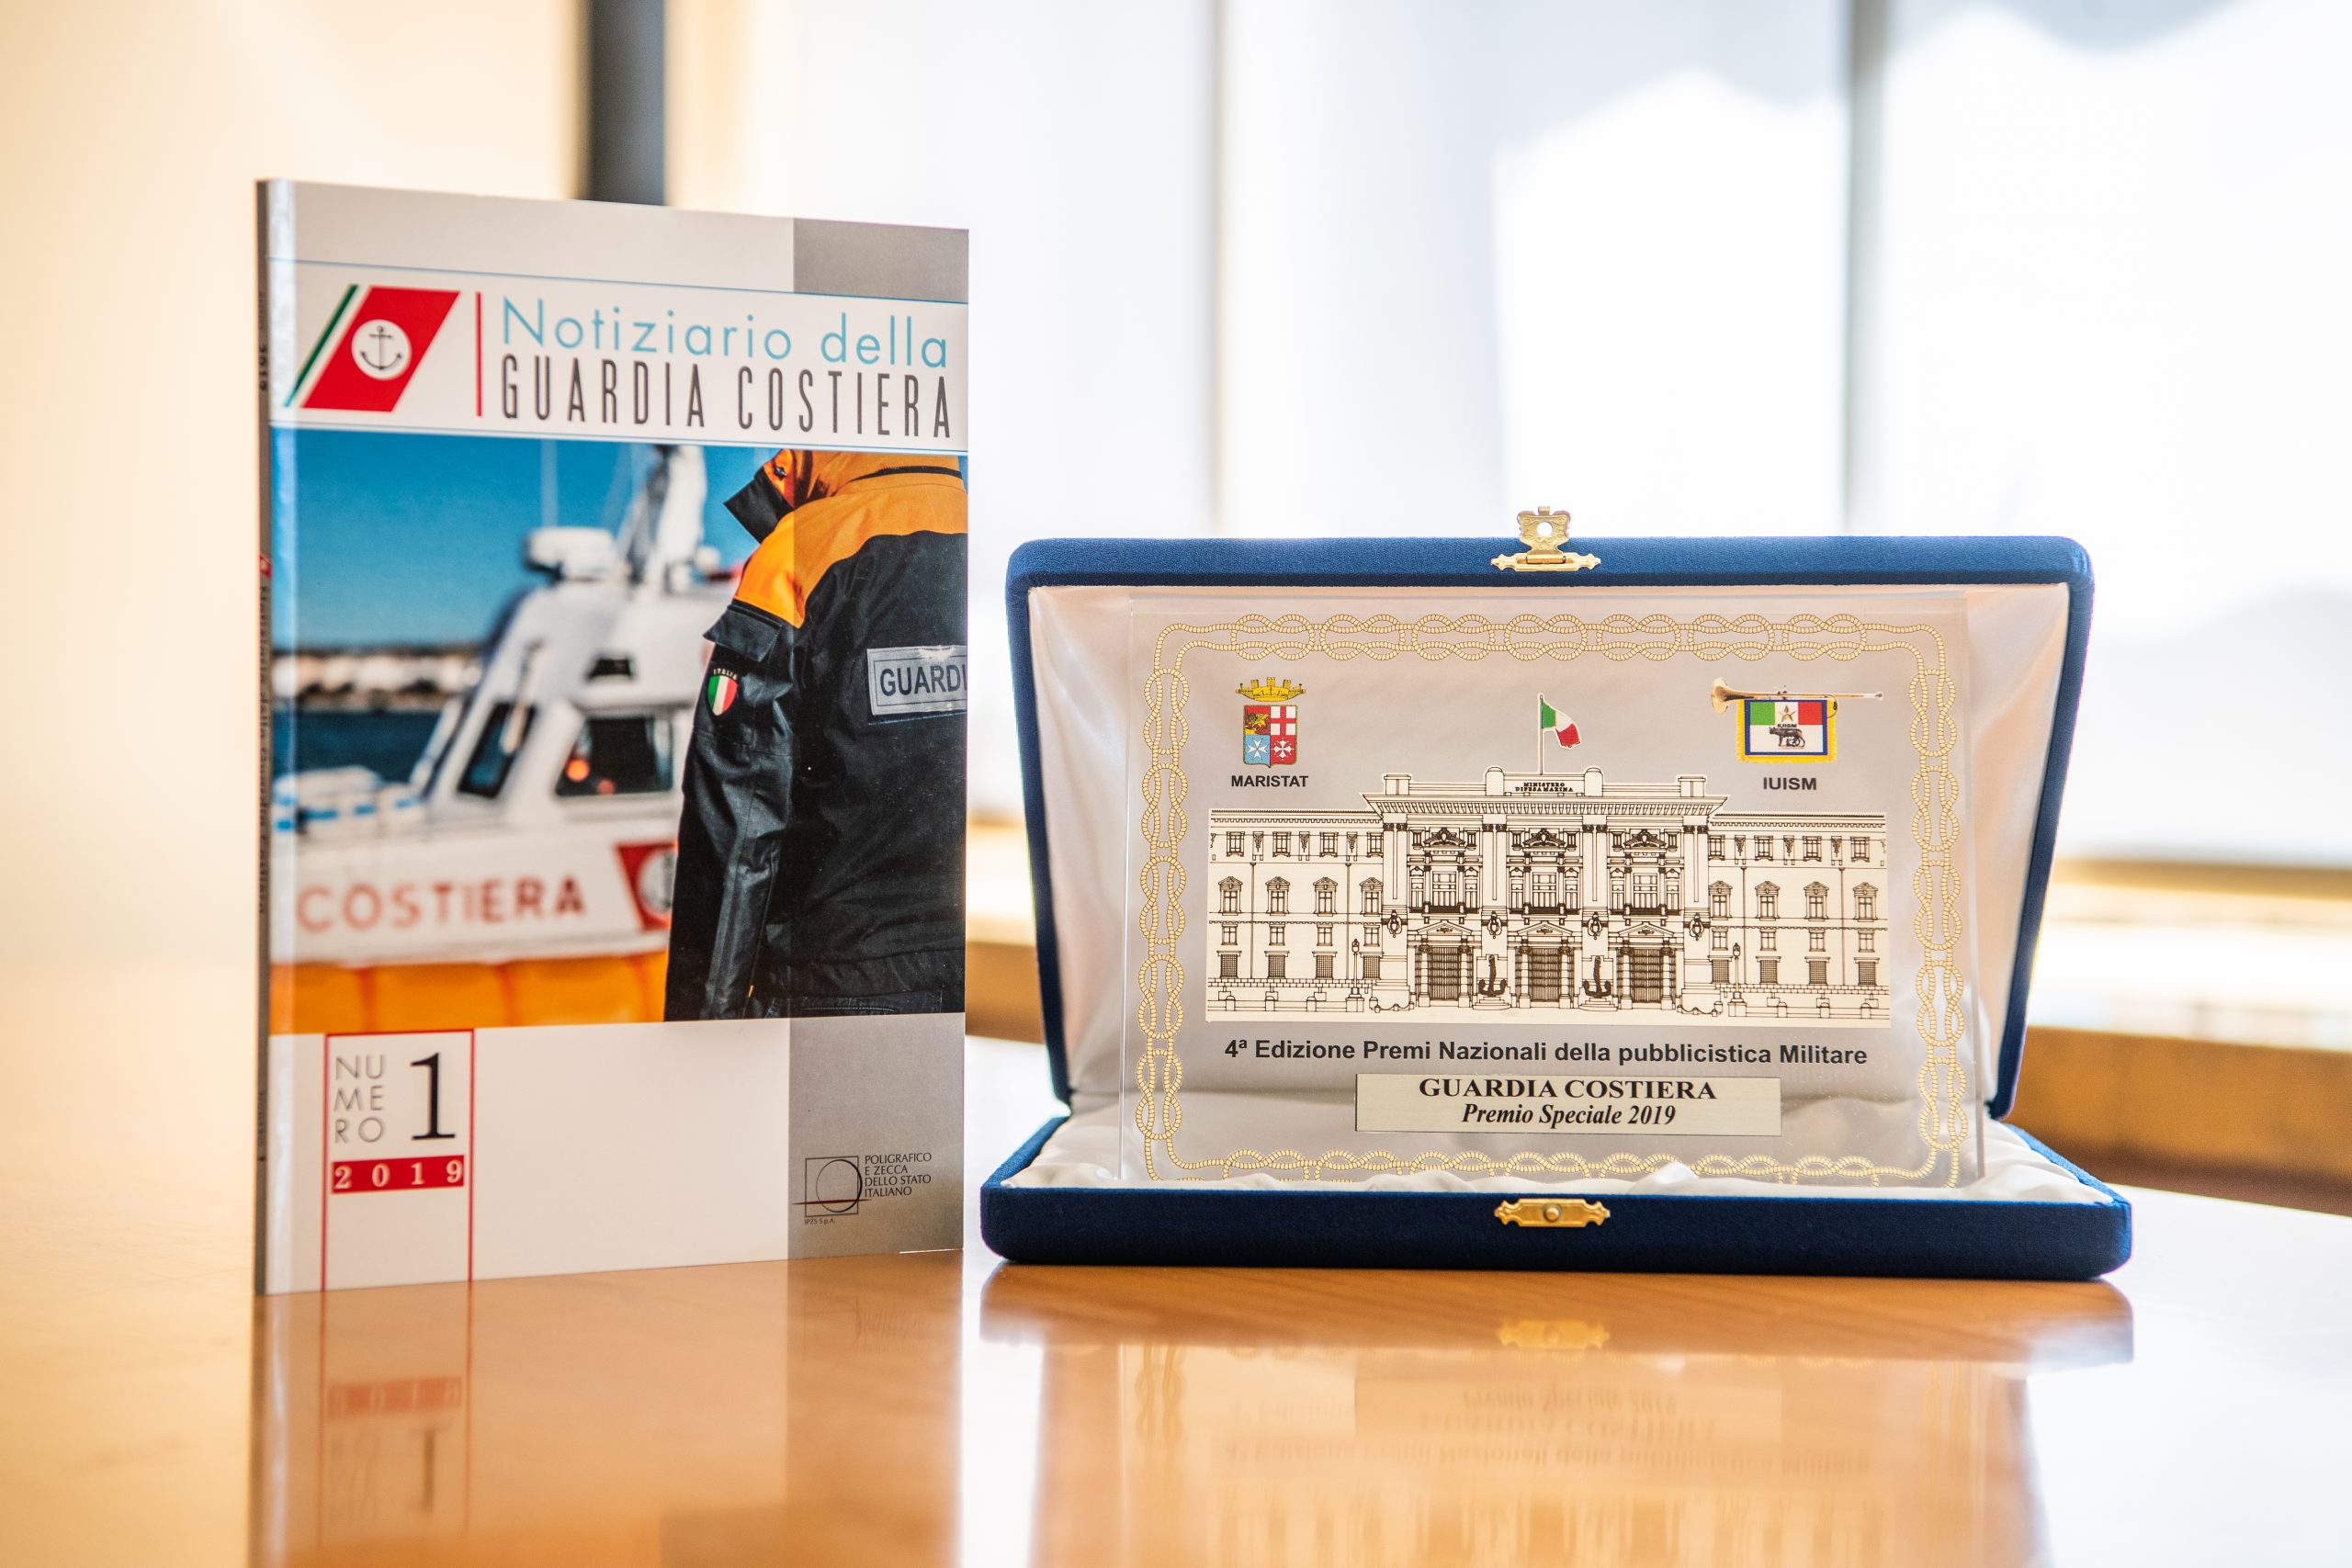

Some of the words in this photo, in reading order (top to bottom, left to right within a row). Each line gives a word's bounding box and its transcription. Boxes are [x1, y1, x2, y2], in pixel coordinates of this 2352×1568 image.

[503, 296, 792, 360] Notiziario
[820, 311, 946, 368] della
[502, 353, 705, 428] GUARDIA
[738, 366, 951, 438] COSTIERA
[713, 668, 738, 681] ITALIA
[1231, 774, 1309, 788] MARISTAT
[1763, 776, 1817, 791] IUISM
[294, 874, 585, 933] COSTIERA
[1255, 1039, 1355, 1058] Edizione
[1363, 1041, 1430, 1059] Premi
[1439, 1041, 1547, 1061] Nazionali
[1555, 1043, 1611, 1062] della
[1618, 1043, 1771, 1066] pubblicistica
[1780, 1045, 1868, 1065] Militare
[410, 1052, 456, 1141] 1
[1419, 1077, 1557, 1098] GUARDIA
[1565, 1079, 1717, 1100] COSTIERA
[1461, 1103, 1533, 1123] Premio
[1538, 1104, 1623, 1129] Speciale
[1627, 1105, 1676, 1125] 2019
[865, 1152, 933, 1165] POLIGRAFICO
[334, 1159, 464, 1190] 2019
[865, 1166, 870, 1176] E
[874, 1165, 908, 1176] ZECCA
[865, 1177, 898, 1187] DELLO
[900, 1174, 932, 1185] STATO
[865, 1186, 912, 1198] ITALIANO
